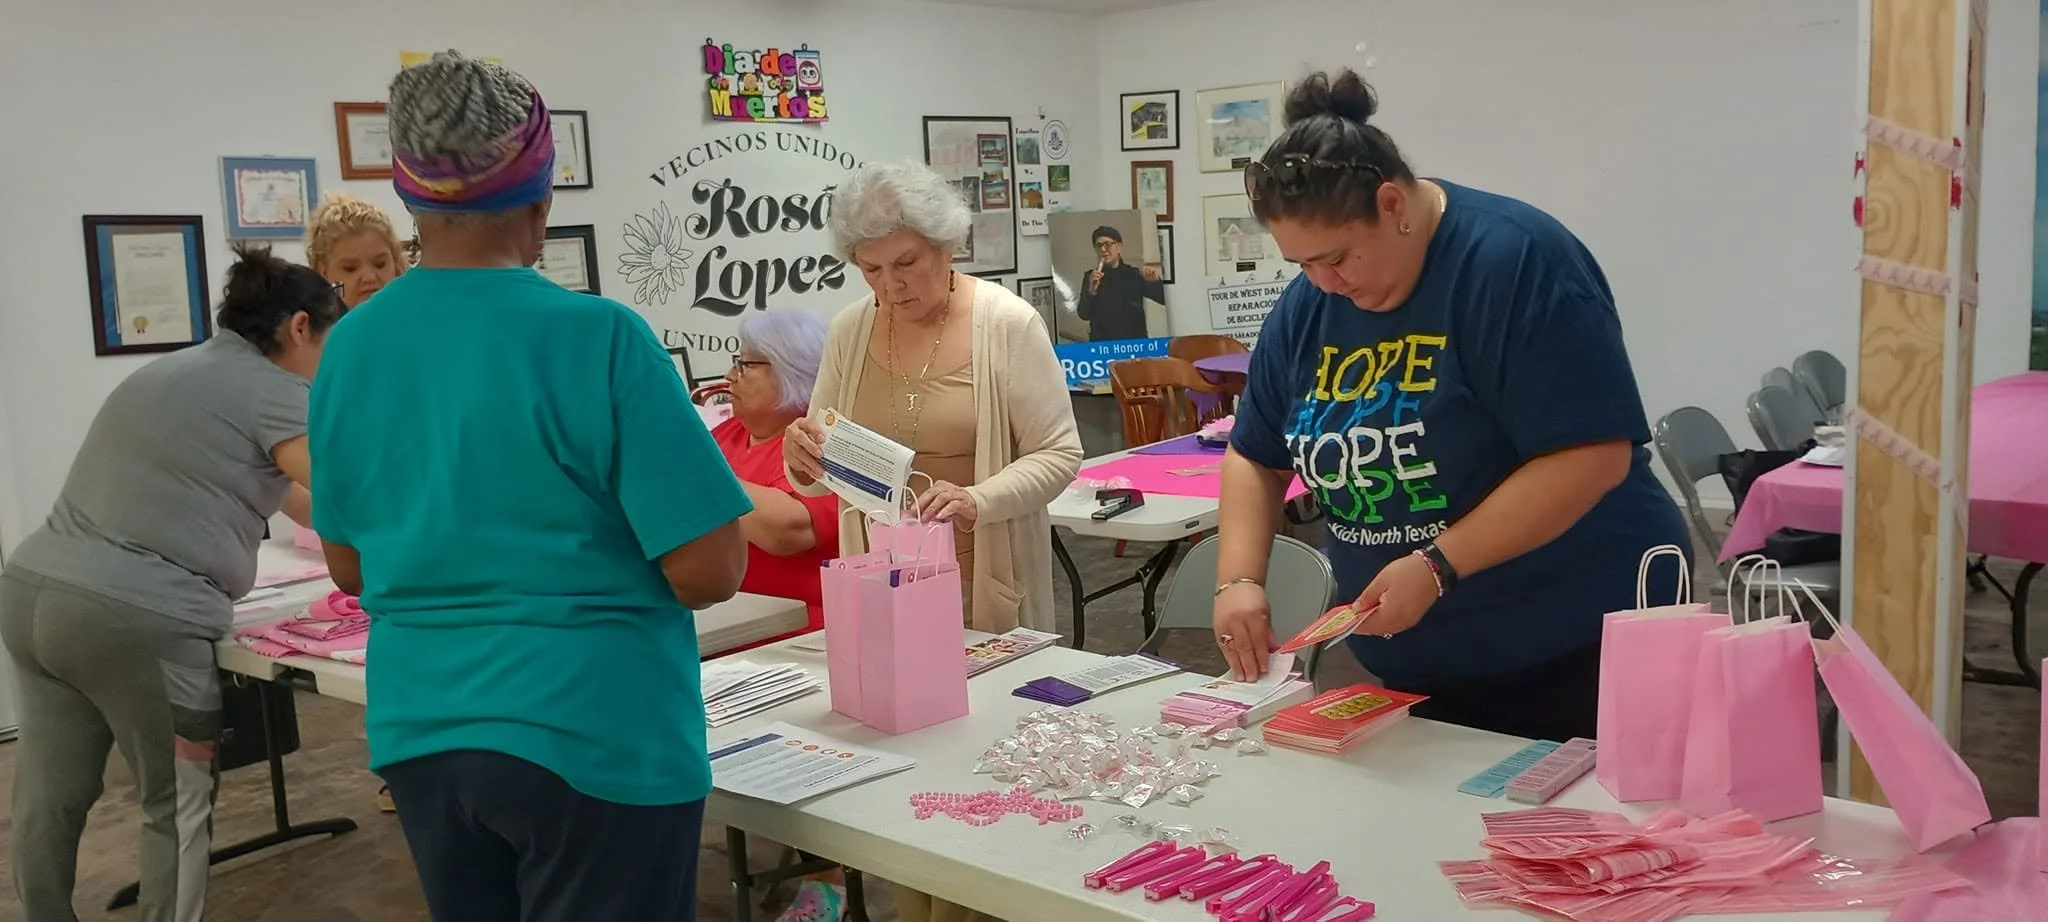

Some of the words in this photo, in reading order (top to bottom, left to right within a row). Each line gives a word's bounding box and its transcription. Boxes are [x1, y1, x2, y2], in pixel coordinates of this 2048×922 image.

[760, 48, 797, 77] de
[709, 89, 828, 118] Muertos
[649, 131, 767, 188] VECINOS
[690, 245, 847, 317] Lopez
[1211, 293, 1229, 302] TOUR
[1230, 291, 1239, 300] DE
[1240, 288, 1263, 299] WEST
[1228, 298, 1277, 312] REPARACIÓ
[1226, 316, 1236, 325] DE
[662, 329, 741, 354] UNIDO
[1099, 345, 1110, 355] In
[1113, 342, 1144, 354] Honor
[1148, 340, 1159, 351] of
[1285, 421, 1438, 490] HOPE
[1320, 460, 1448, 524] OPE
[1360, 527, 1402, 546] North
[1404, 519, 1449, 544] Texas
